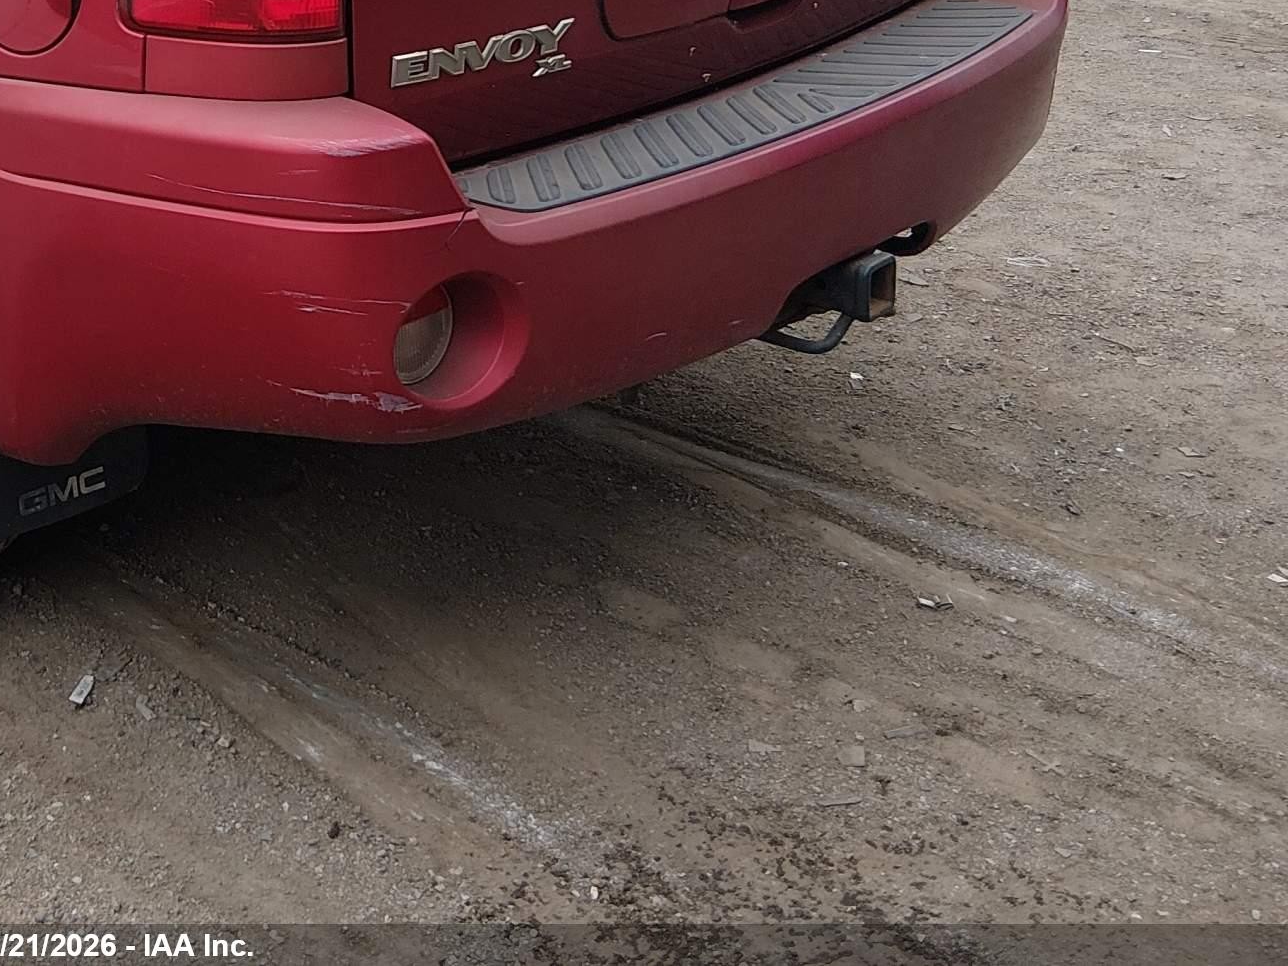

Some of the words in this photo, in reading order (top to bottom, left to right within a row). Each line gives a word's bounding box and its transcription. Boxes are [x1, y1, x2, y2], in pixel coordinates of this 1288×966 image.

[390, 17, 576, 89] ENVOY
[531, 53, 573, 78] XL
[18, 465, 106, 516] GMC
